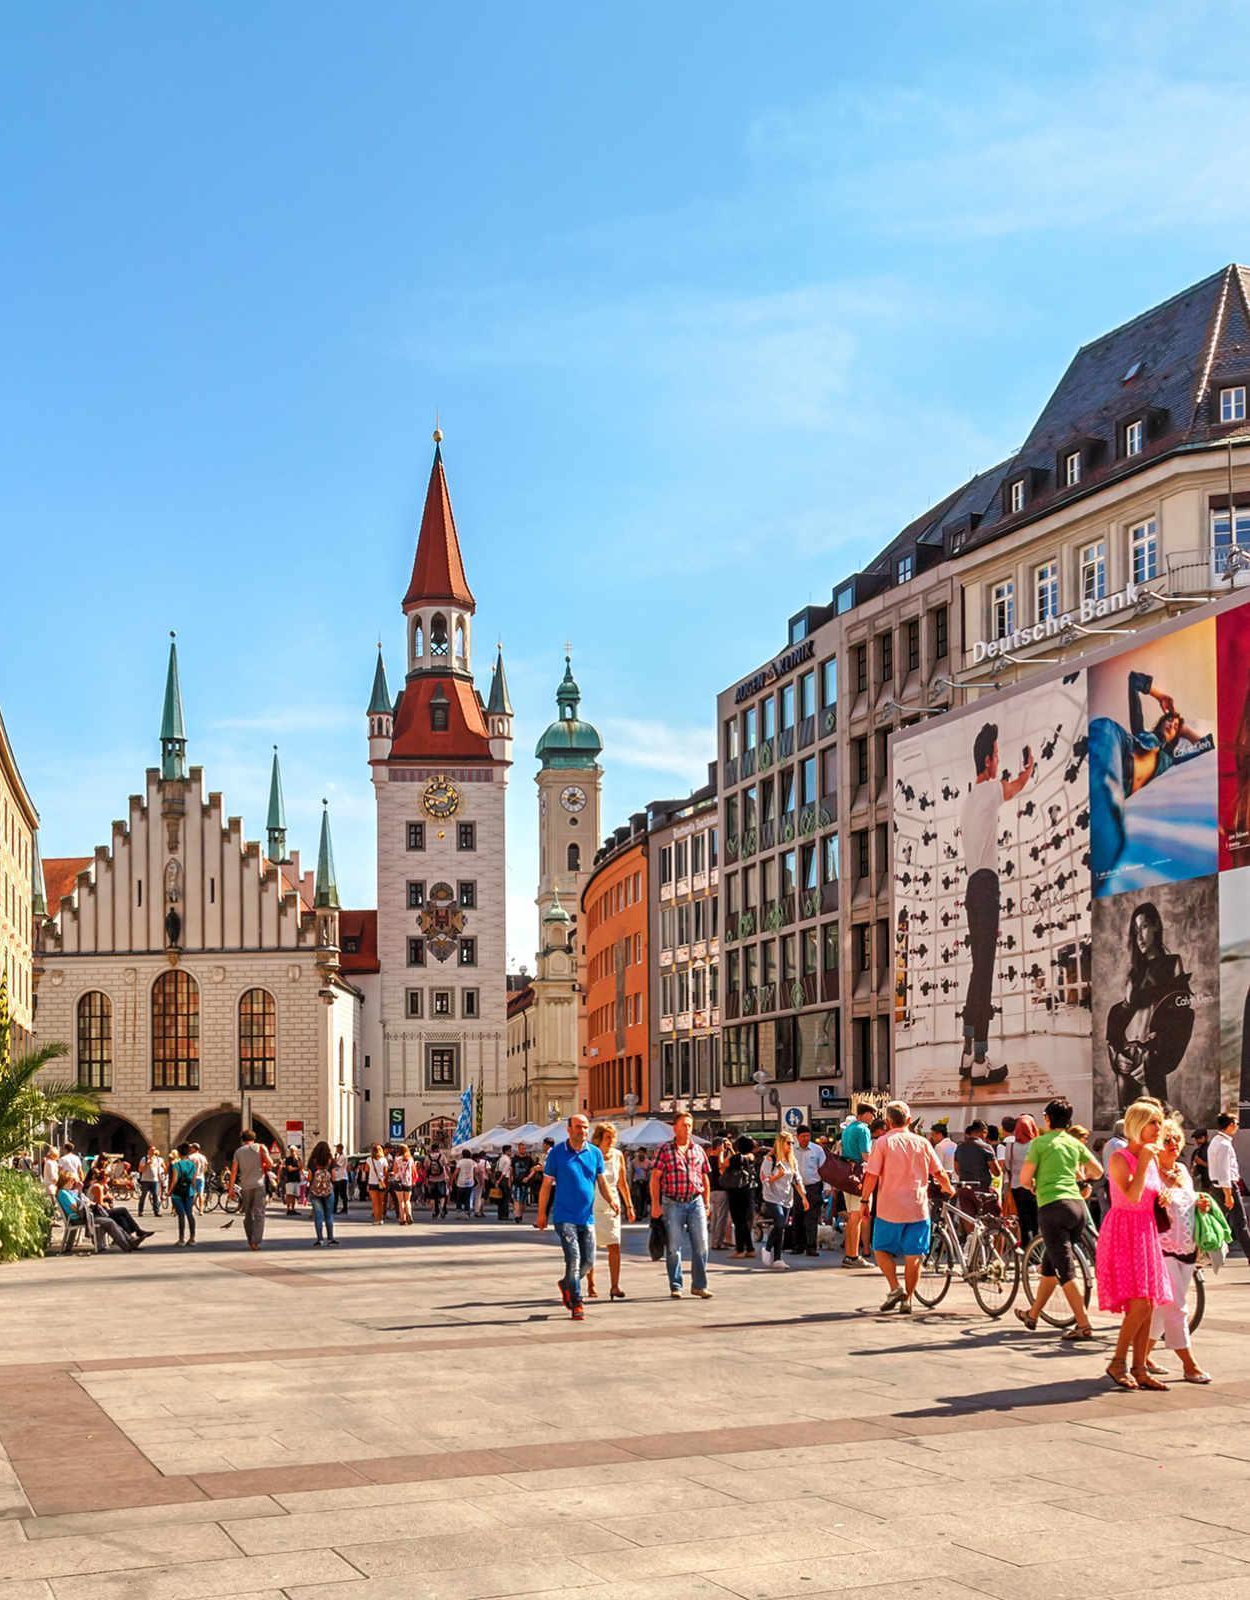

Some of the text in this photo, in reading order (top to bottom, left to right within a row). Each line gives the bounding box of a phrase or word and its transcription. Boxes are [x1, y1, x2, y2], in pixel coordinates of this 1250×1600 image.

[973, 581, 1139, 664] Deutsche Bank
[780, 639, 816, 677] KLINIK
[392, 1109, 403, 1122] S
[392, 1124, 403, 1137] U
